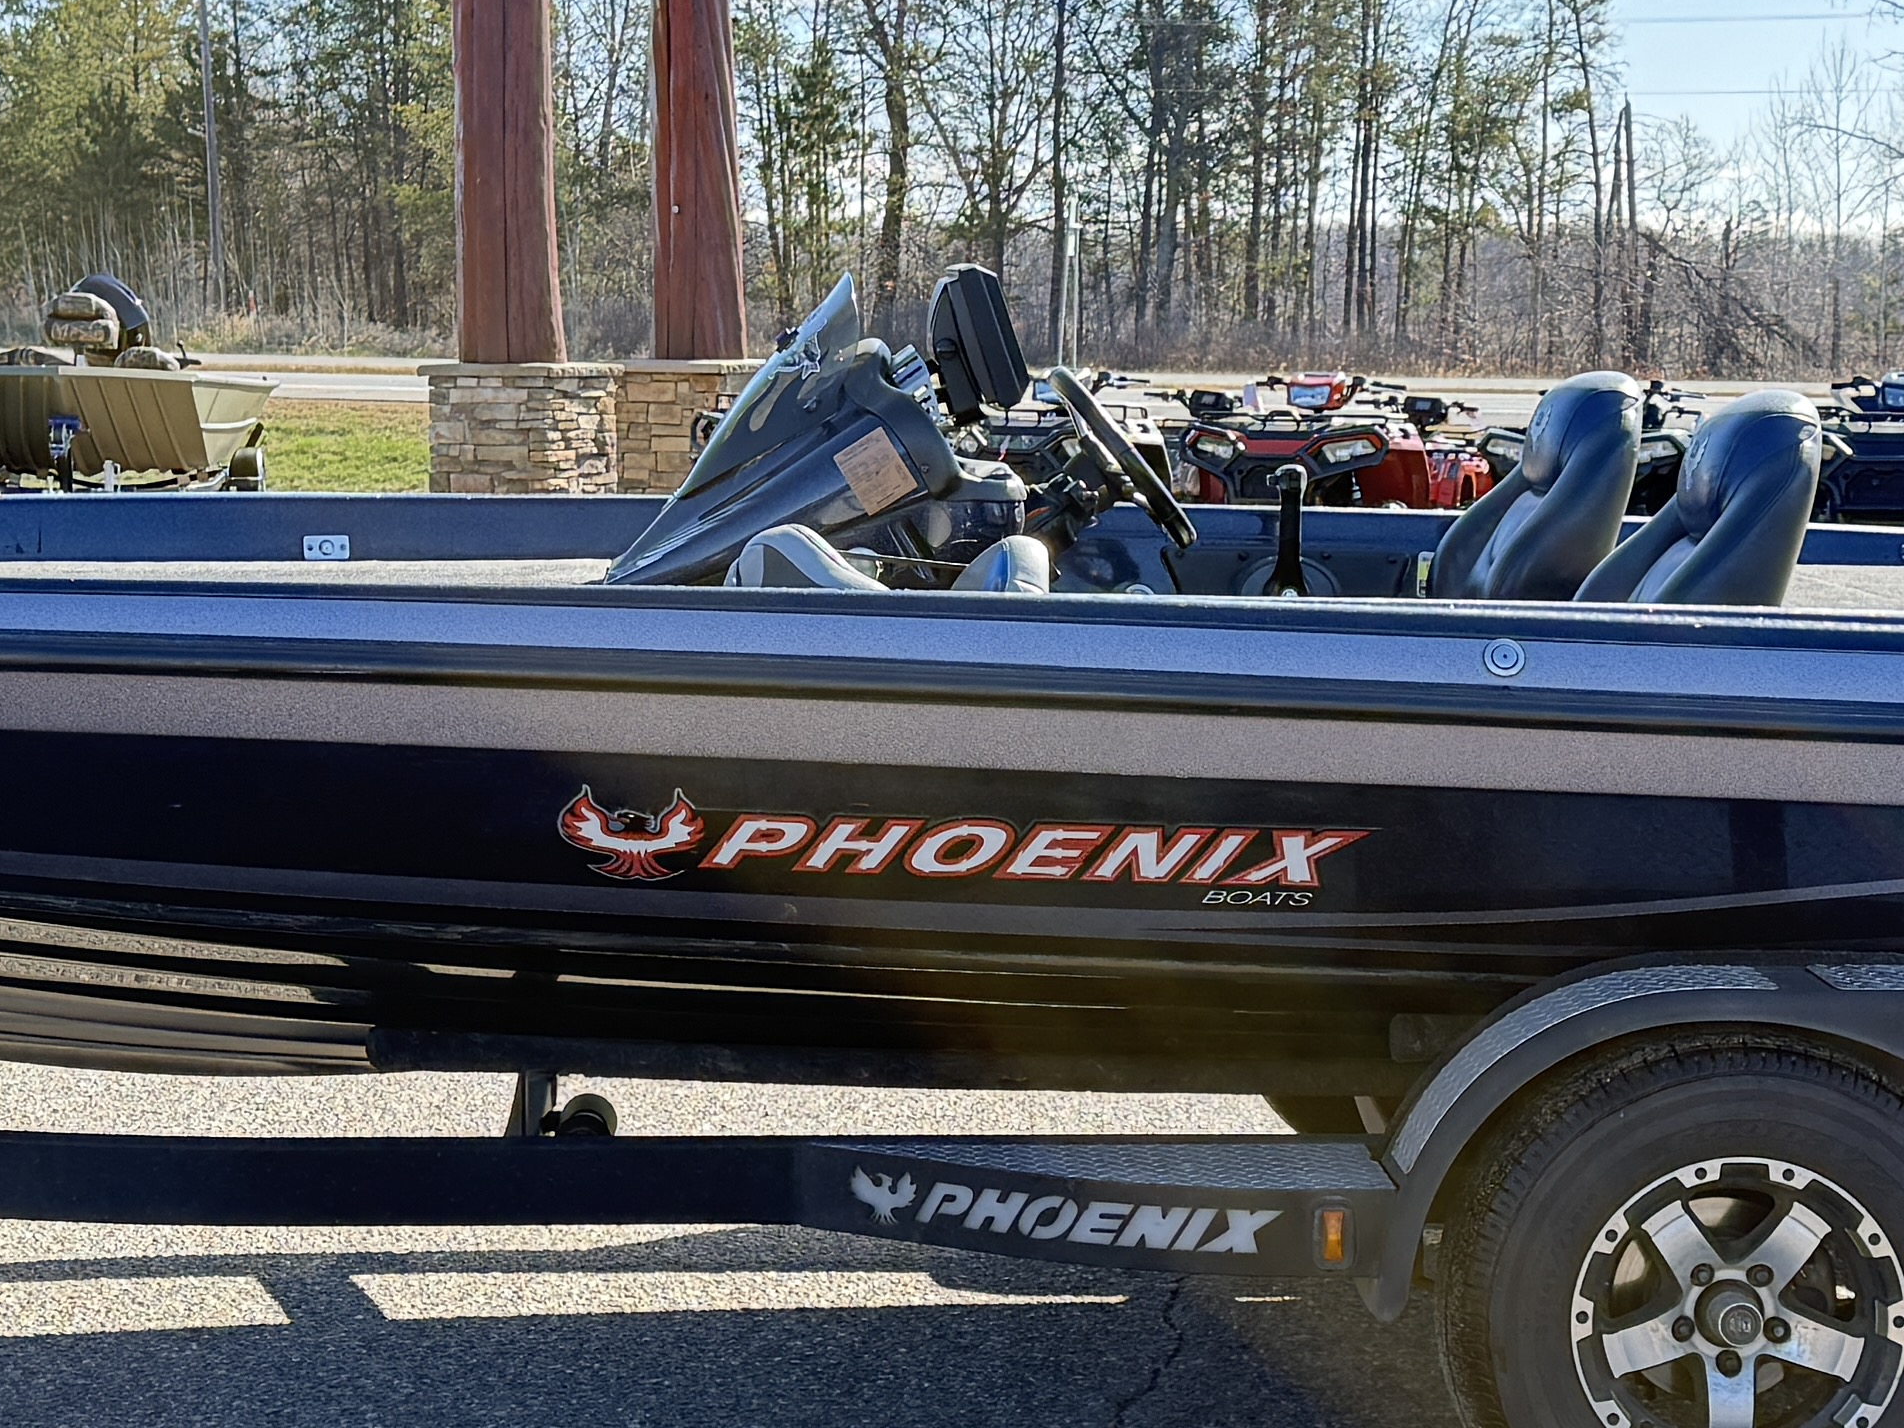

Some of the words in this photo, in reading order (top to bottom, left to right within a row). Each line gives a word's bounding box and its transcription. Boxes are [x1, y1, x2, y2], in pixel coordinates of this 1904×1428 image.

[697, 814, 1371, 885] PHOENIX
[1201, 890, 1314, 906] BOATS
[915, 1181, 1284, 1254] PHOENIX
